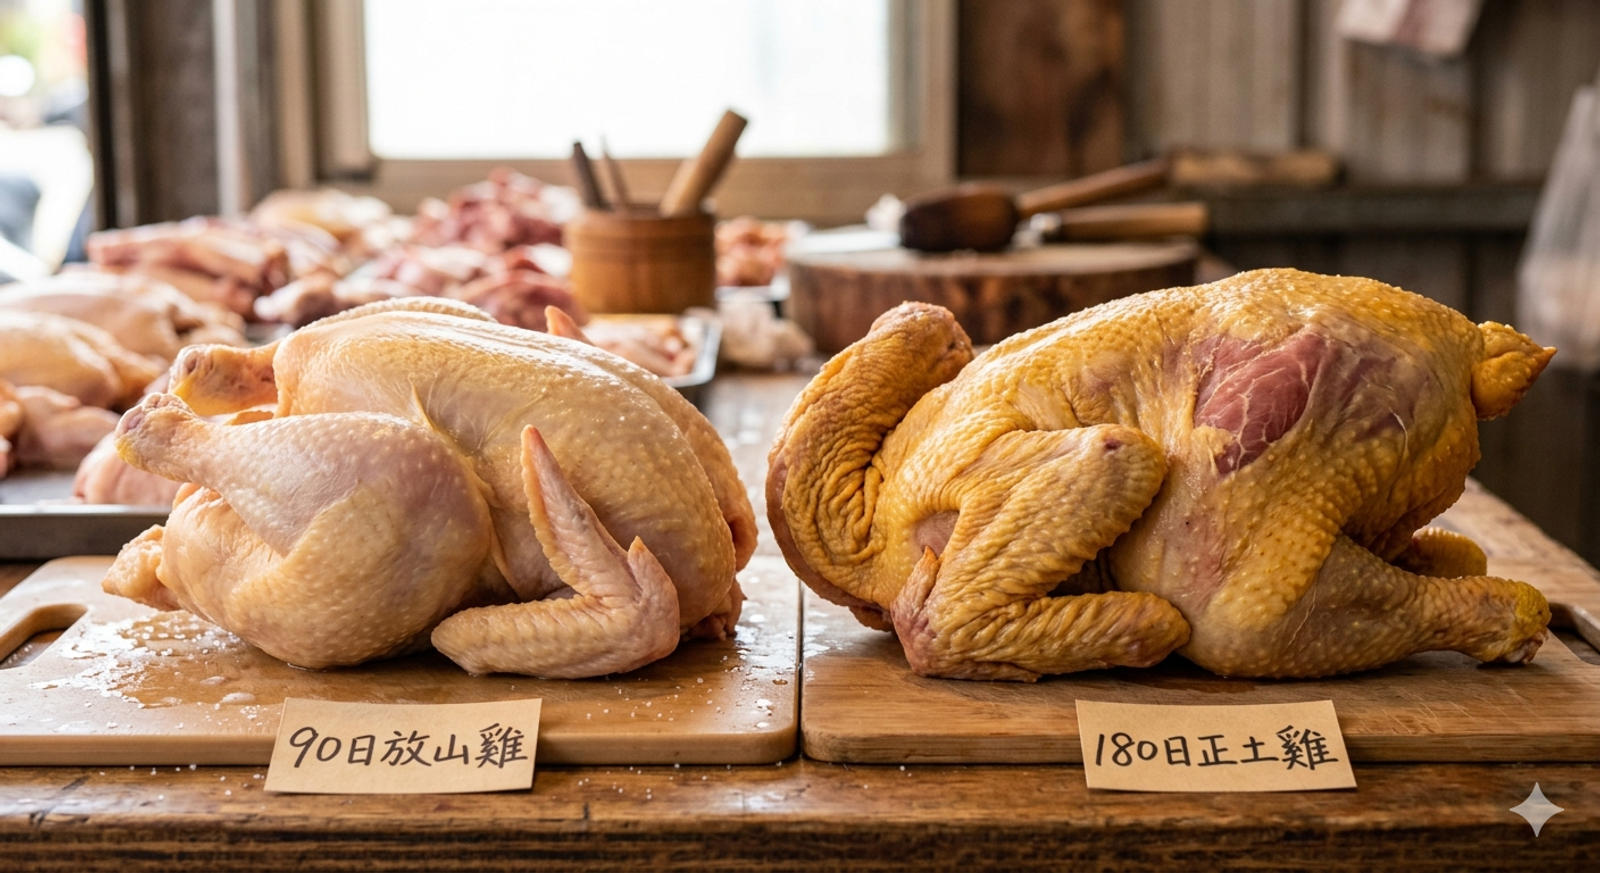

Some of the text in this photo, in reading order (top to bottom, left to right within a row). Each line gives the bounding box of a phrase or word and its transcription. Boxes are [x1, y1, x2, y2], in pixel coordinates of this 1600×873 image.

[289, 723, 528, 768] 90日放山雞
[1095, 725, 1339, 770] 180日正土雞
